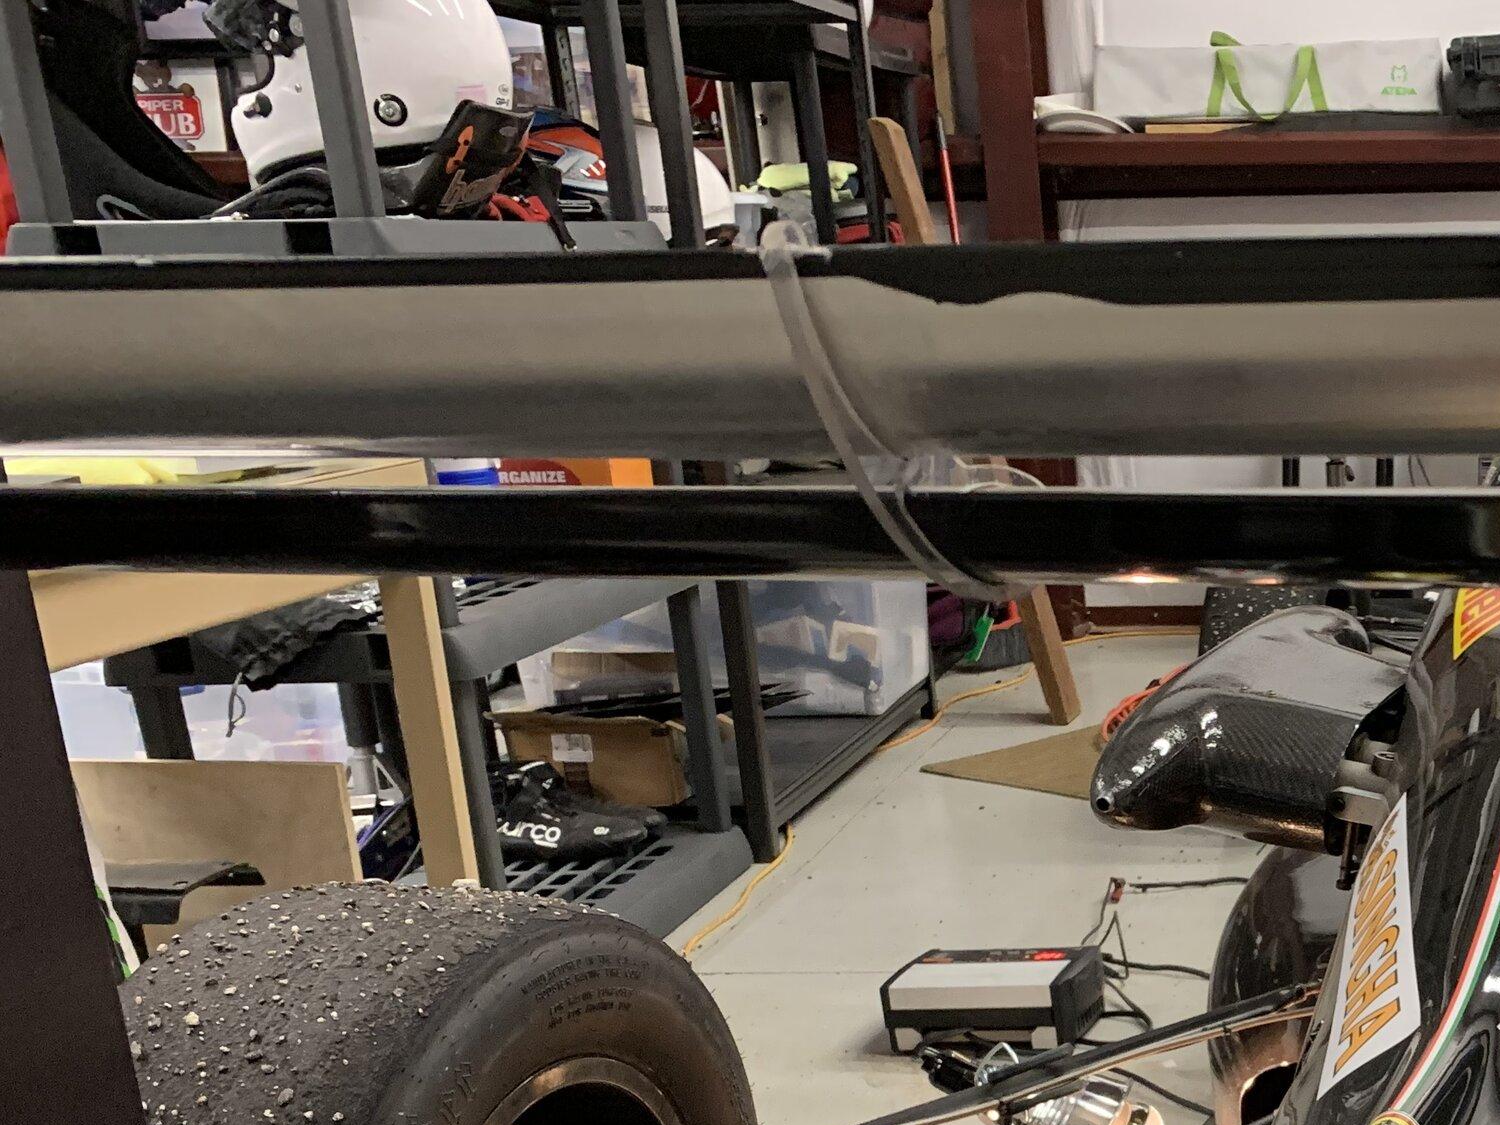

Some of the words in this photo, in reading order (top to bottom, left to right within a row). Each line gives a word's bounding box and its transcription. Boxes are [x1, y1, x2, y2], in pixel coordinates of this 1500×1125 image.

[138, 99, 184, 111] PIPER
[146, 112, 197, 135] UB
[498, 470, 567, 483] RGANIZE
[1333, 849, 1401, 1077] SINGHA
